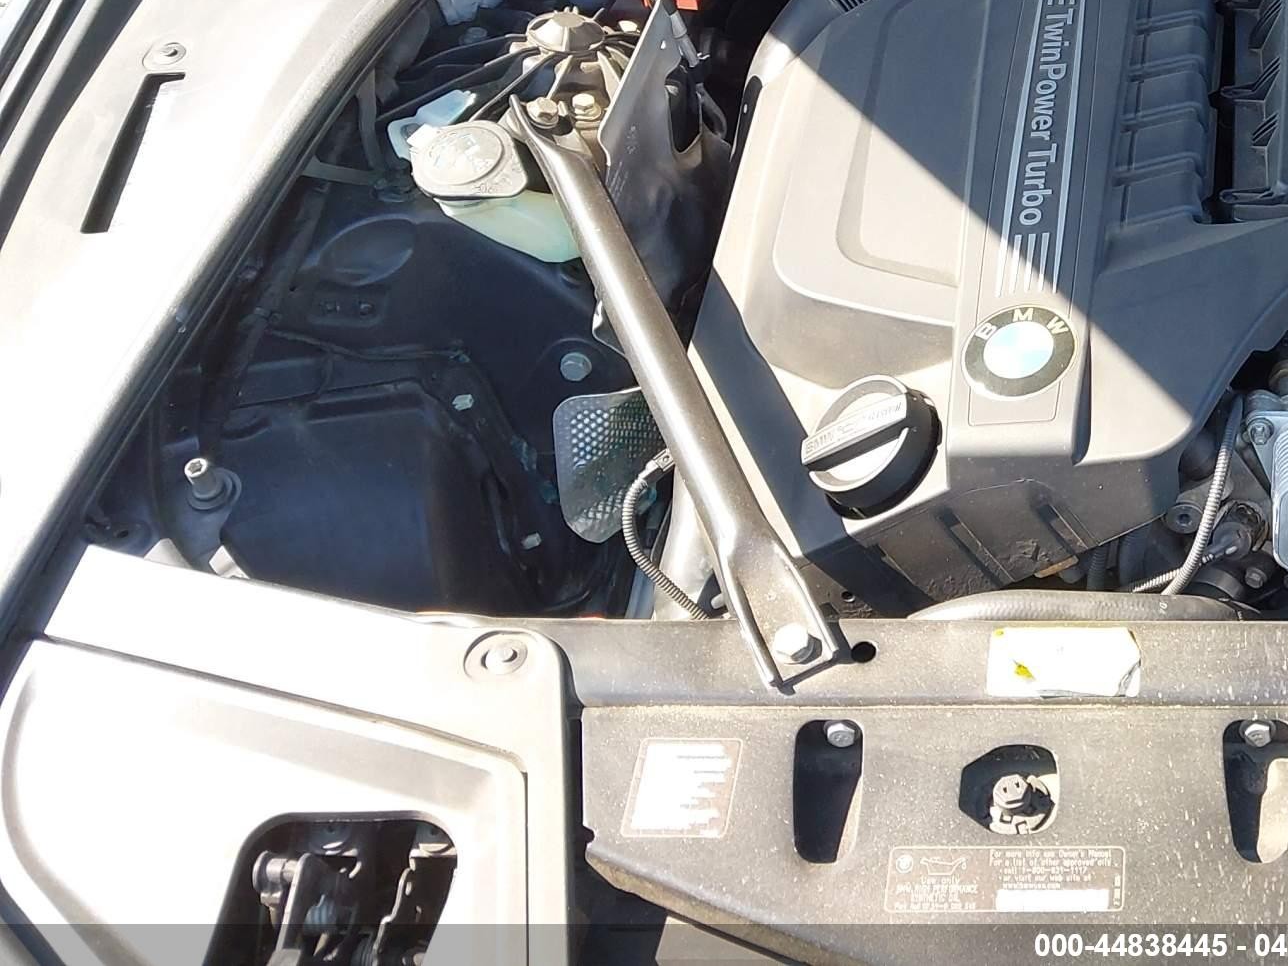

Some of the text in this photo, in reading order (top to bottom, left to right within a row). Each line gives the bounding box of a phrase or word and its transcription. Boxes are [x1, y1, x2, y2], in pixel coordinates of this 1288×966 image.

[1018, 8, 1074, 227] TwinPower Turbo
[974, 307, 1070, 341] BMW
